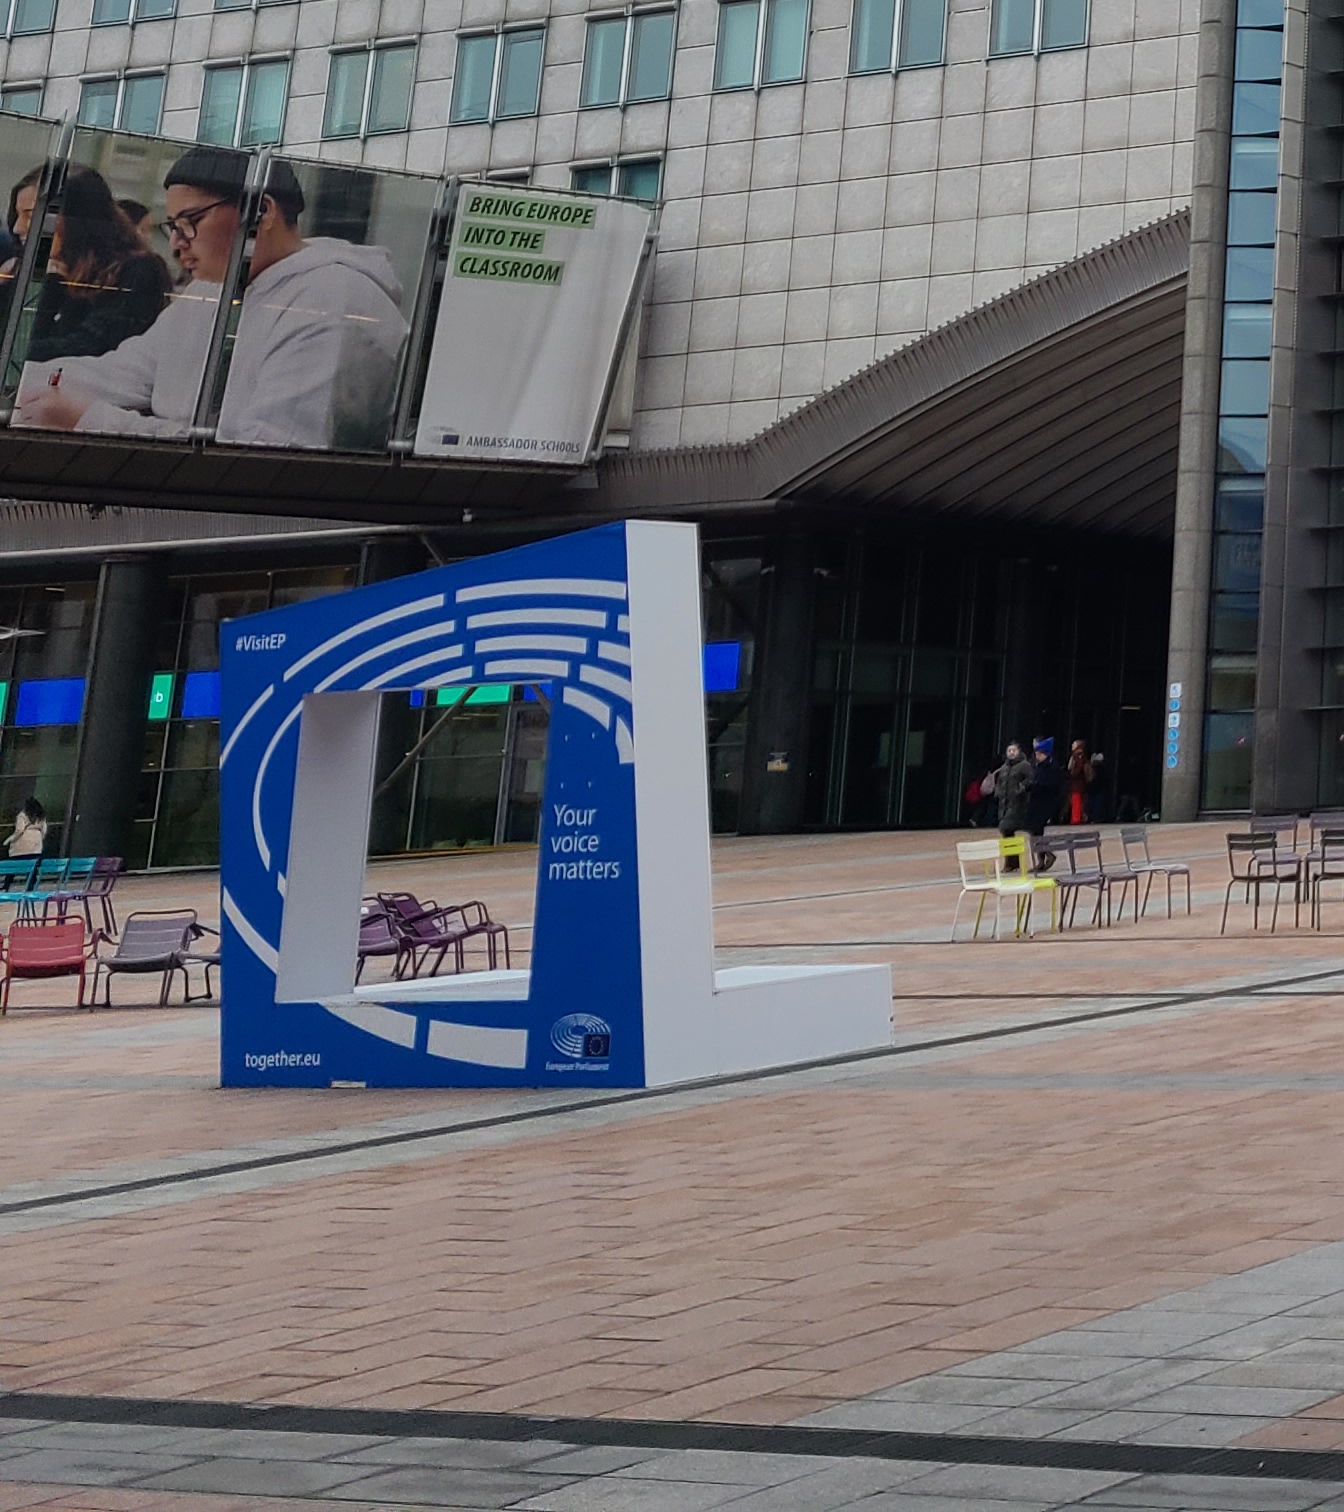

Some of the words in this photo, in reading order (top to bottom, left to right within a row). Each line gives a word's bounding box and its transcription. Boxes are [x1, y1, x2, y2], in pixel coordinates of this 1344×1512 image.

[469, 196, 525, 217] BRING
[526, 202, 594, 225] EUROPE
[463, 226, 506, 245] INTO
[508, 231, 543, 249] THE
[459, 256, 561, 283] CLASSROOM
[466, 435, 538, 451] AMBASSADOR
[540, 439, 581, 454] SCHOOLS
[235, 633, 287, 652] #VisitEP
[553, 803, 598, 827] Your
[550, 830, 599, 853] voice
[548, 859, 620, 880] matters
[245, 1049, 321, 1072] together.eu
